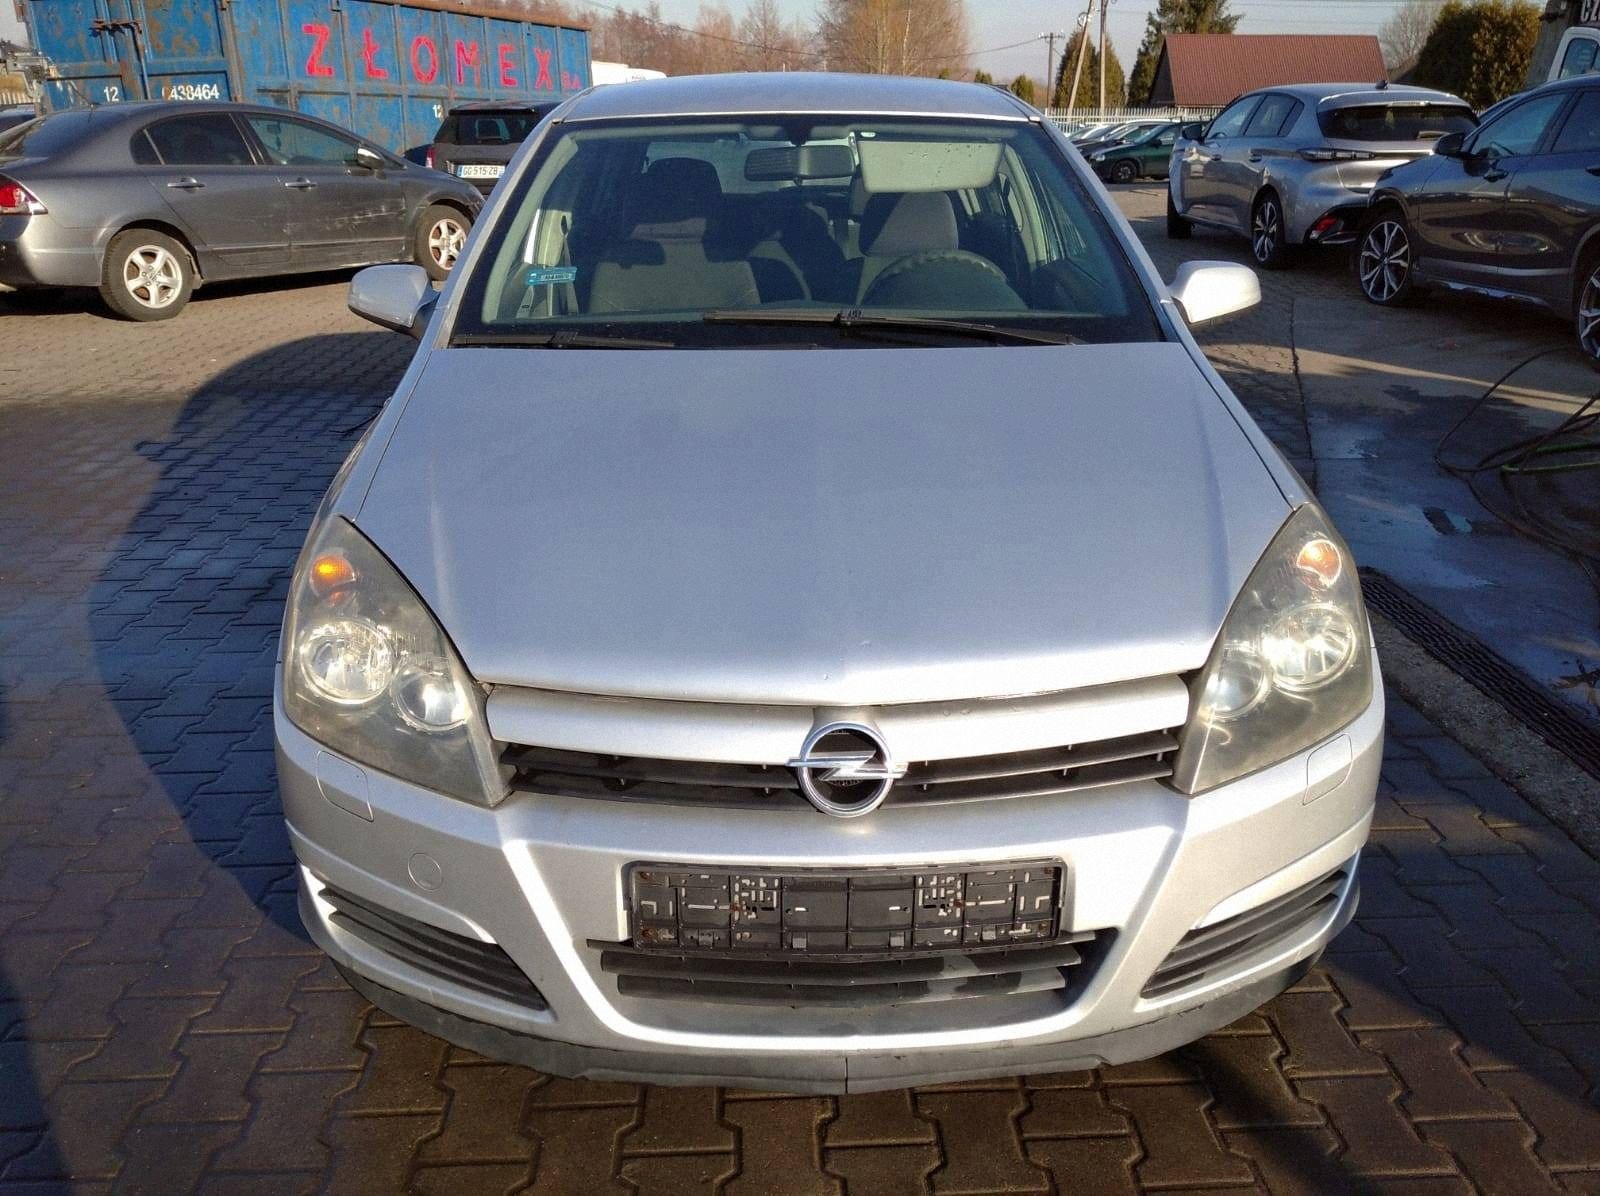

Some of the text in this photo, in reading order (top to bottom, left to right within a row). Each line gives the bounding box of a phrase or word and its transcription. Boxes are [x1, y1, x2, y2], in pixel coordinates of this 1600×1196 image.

[303, 23, 554, 90] ZŁOMEX
[103, 86, 119, 102] 12
[161, 83, 220, 101] 438464
